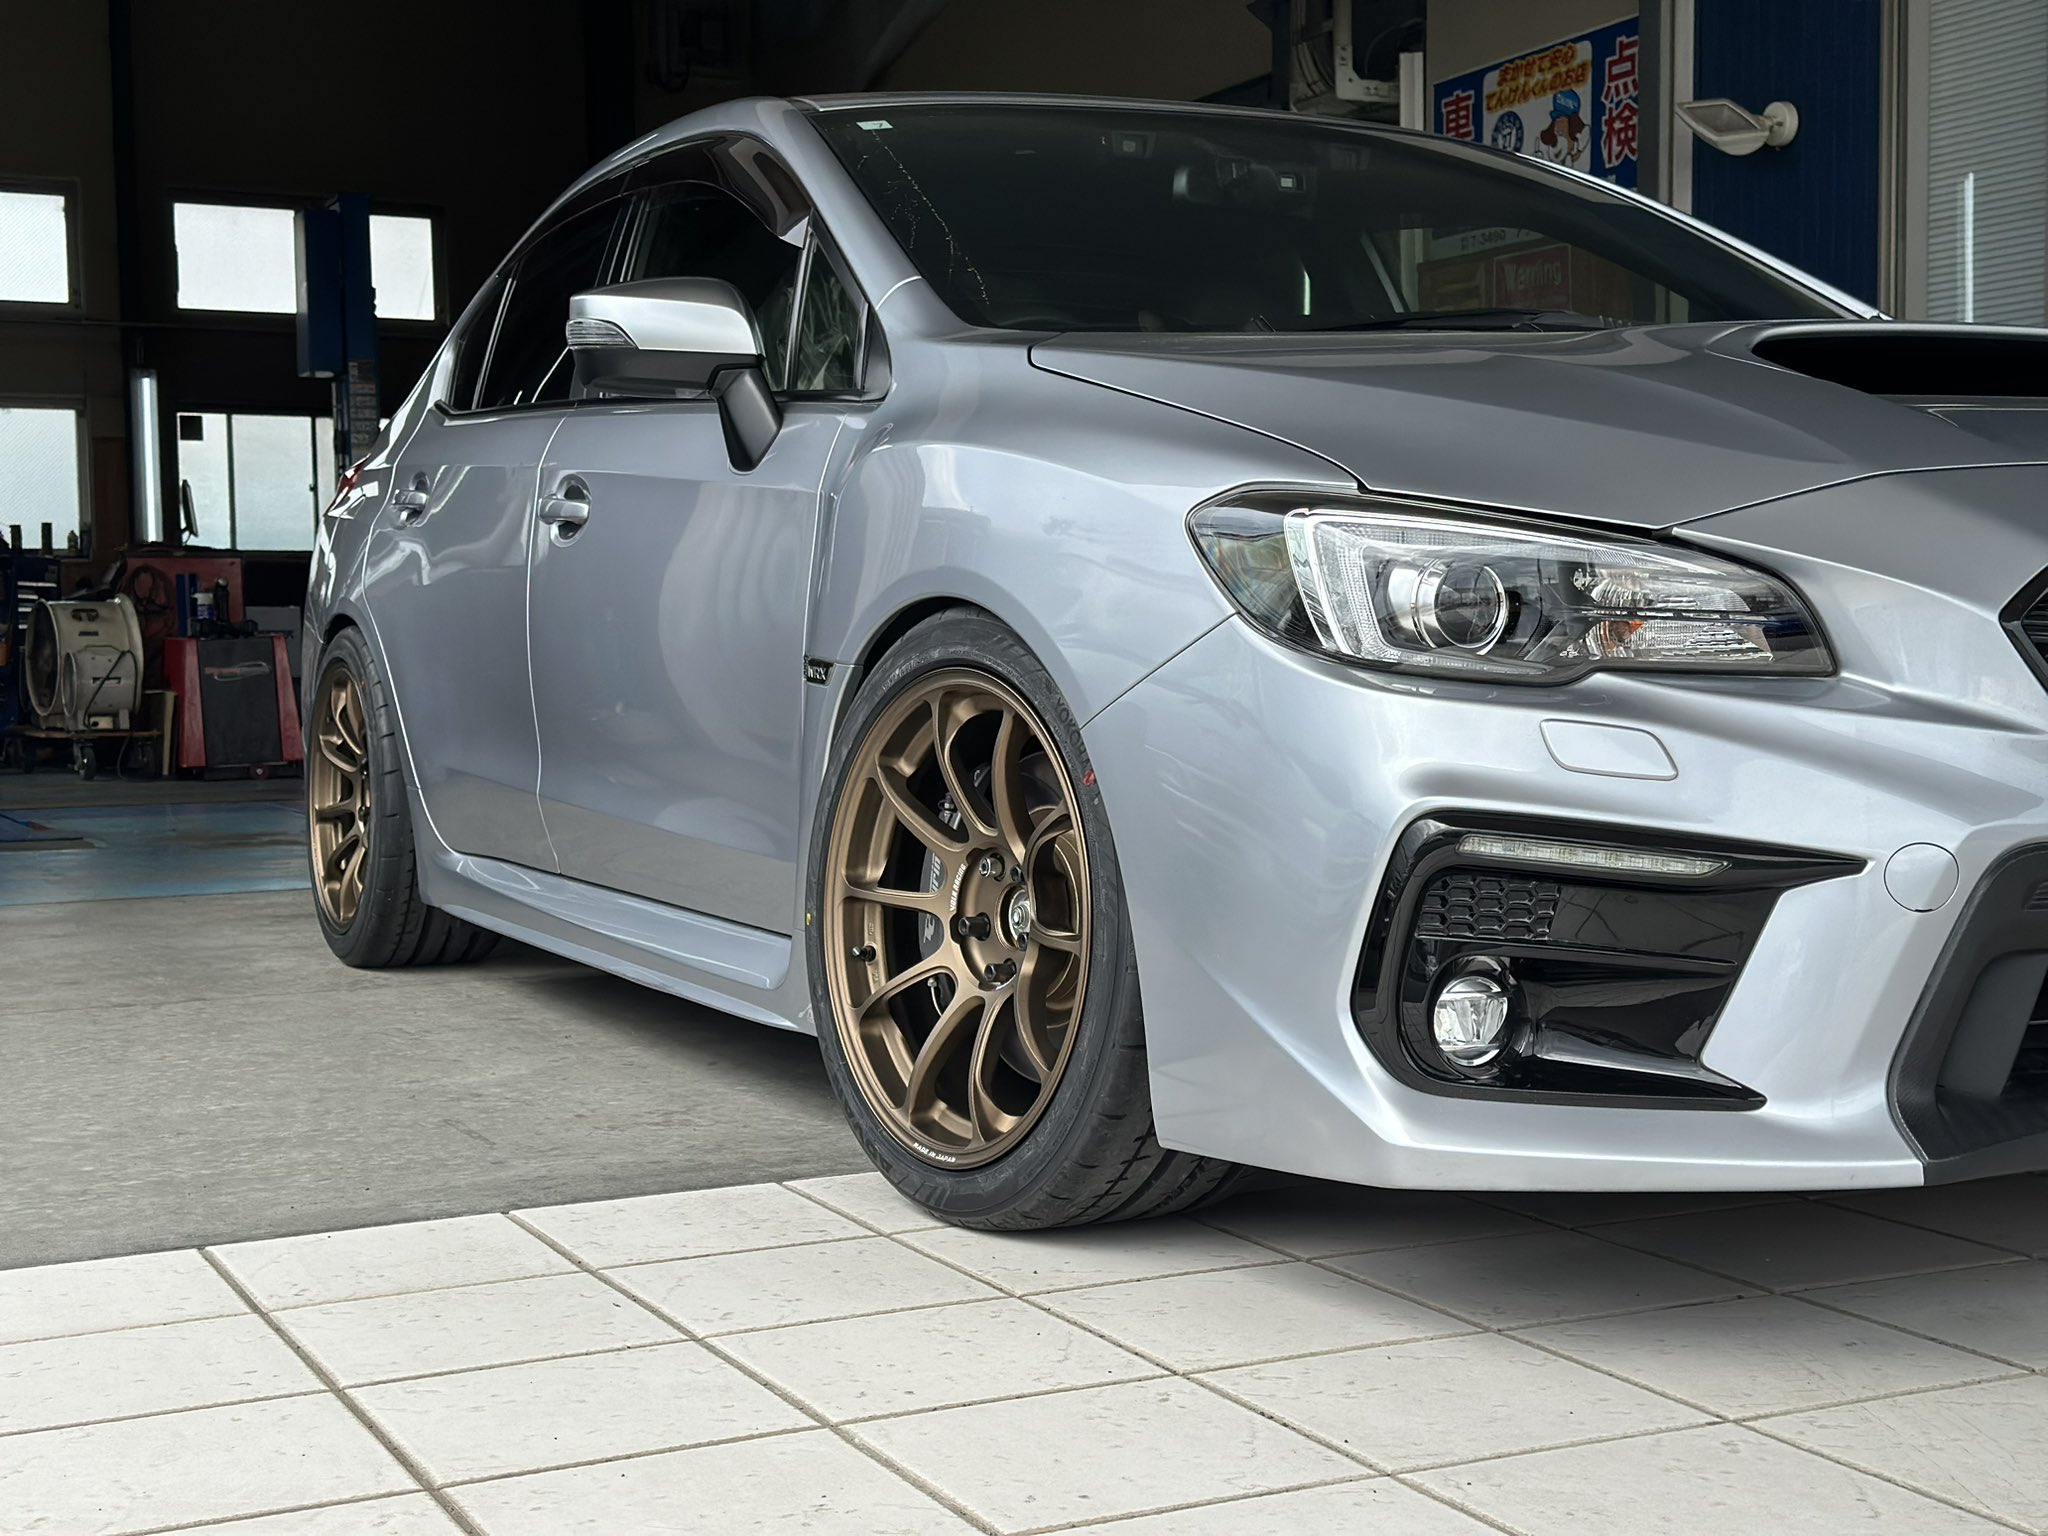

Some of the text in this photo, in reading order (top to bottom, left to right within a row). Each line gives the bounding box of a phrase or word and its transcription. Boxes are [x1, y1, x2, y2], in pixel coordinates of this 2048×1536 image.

[1443, 91, 1474, 140] 車
[1602, 36, 1639, 167] 点検
[1504, 260, 1562, 291] Warning
[807, 665, 827, 681] WRX
[949, 863, 967, 911] VOLK RACING
[912, 1142, 929, 1155] MADE
